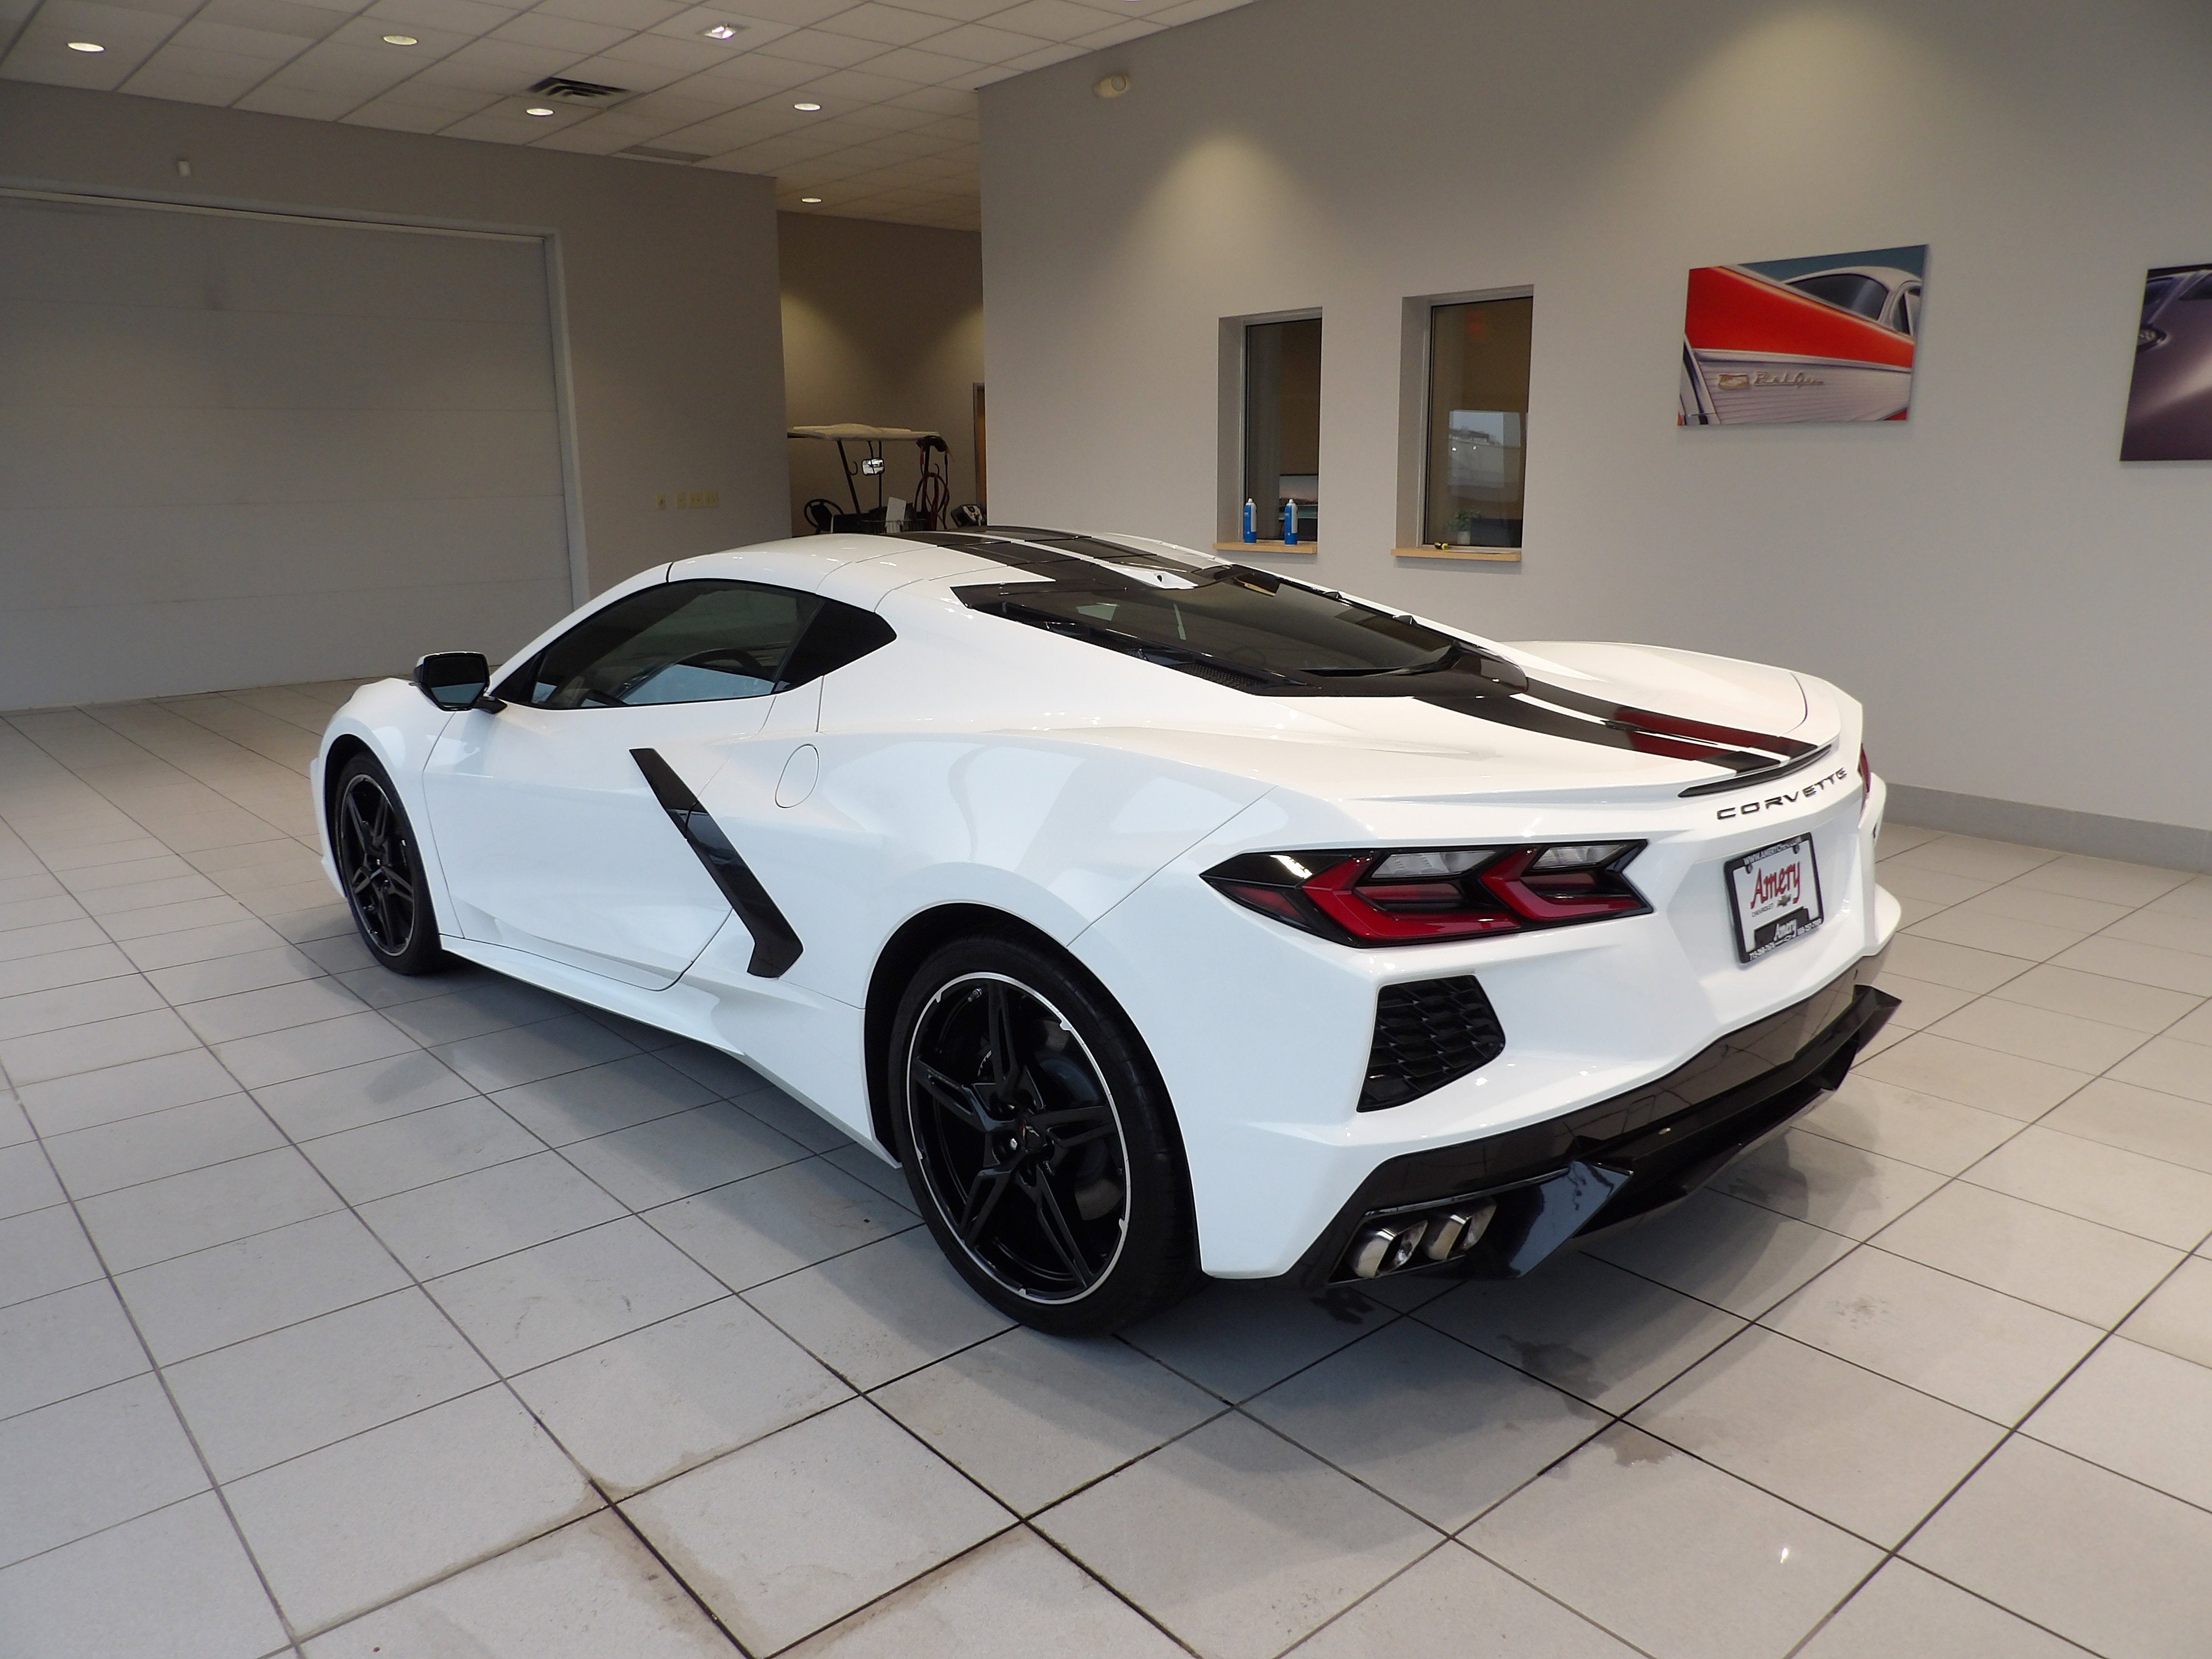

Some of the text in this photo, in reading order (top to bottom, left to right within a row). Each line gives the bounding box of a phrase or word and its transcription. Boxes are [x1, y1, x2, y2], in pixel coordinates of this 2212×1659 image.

[1717, 768, 1848, 820] CORVETTE
[1750, 861, 1801, 909] Amery
[1773, 919, 1797, 941] Amery
